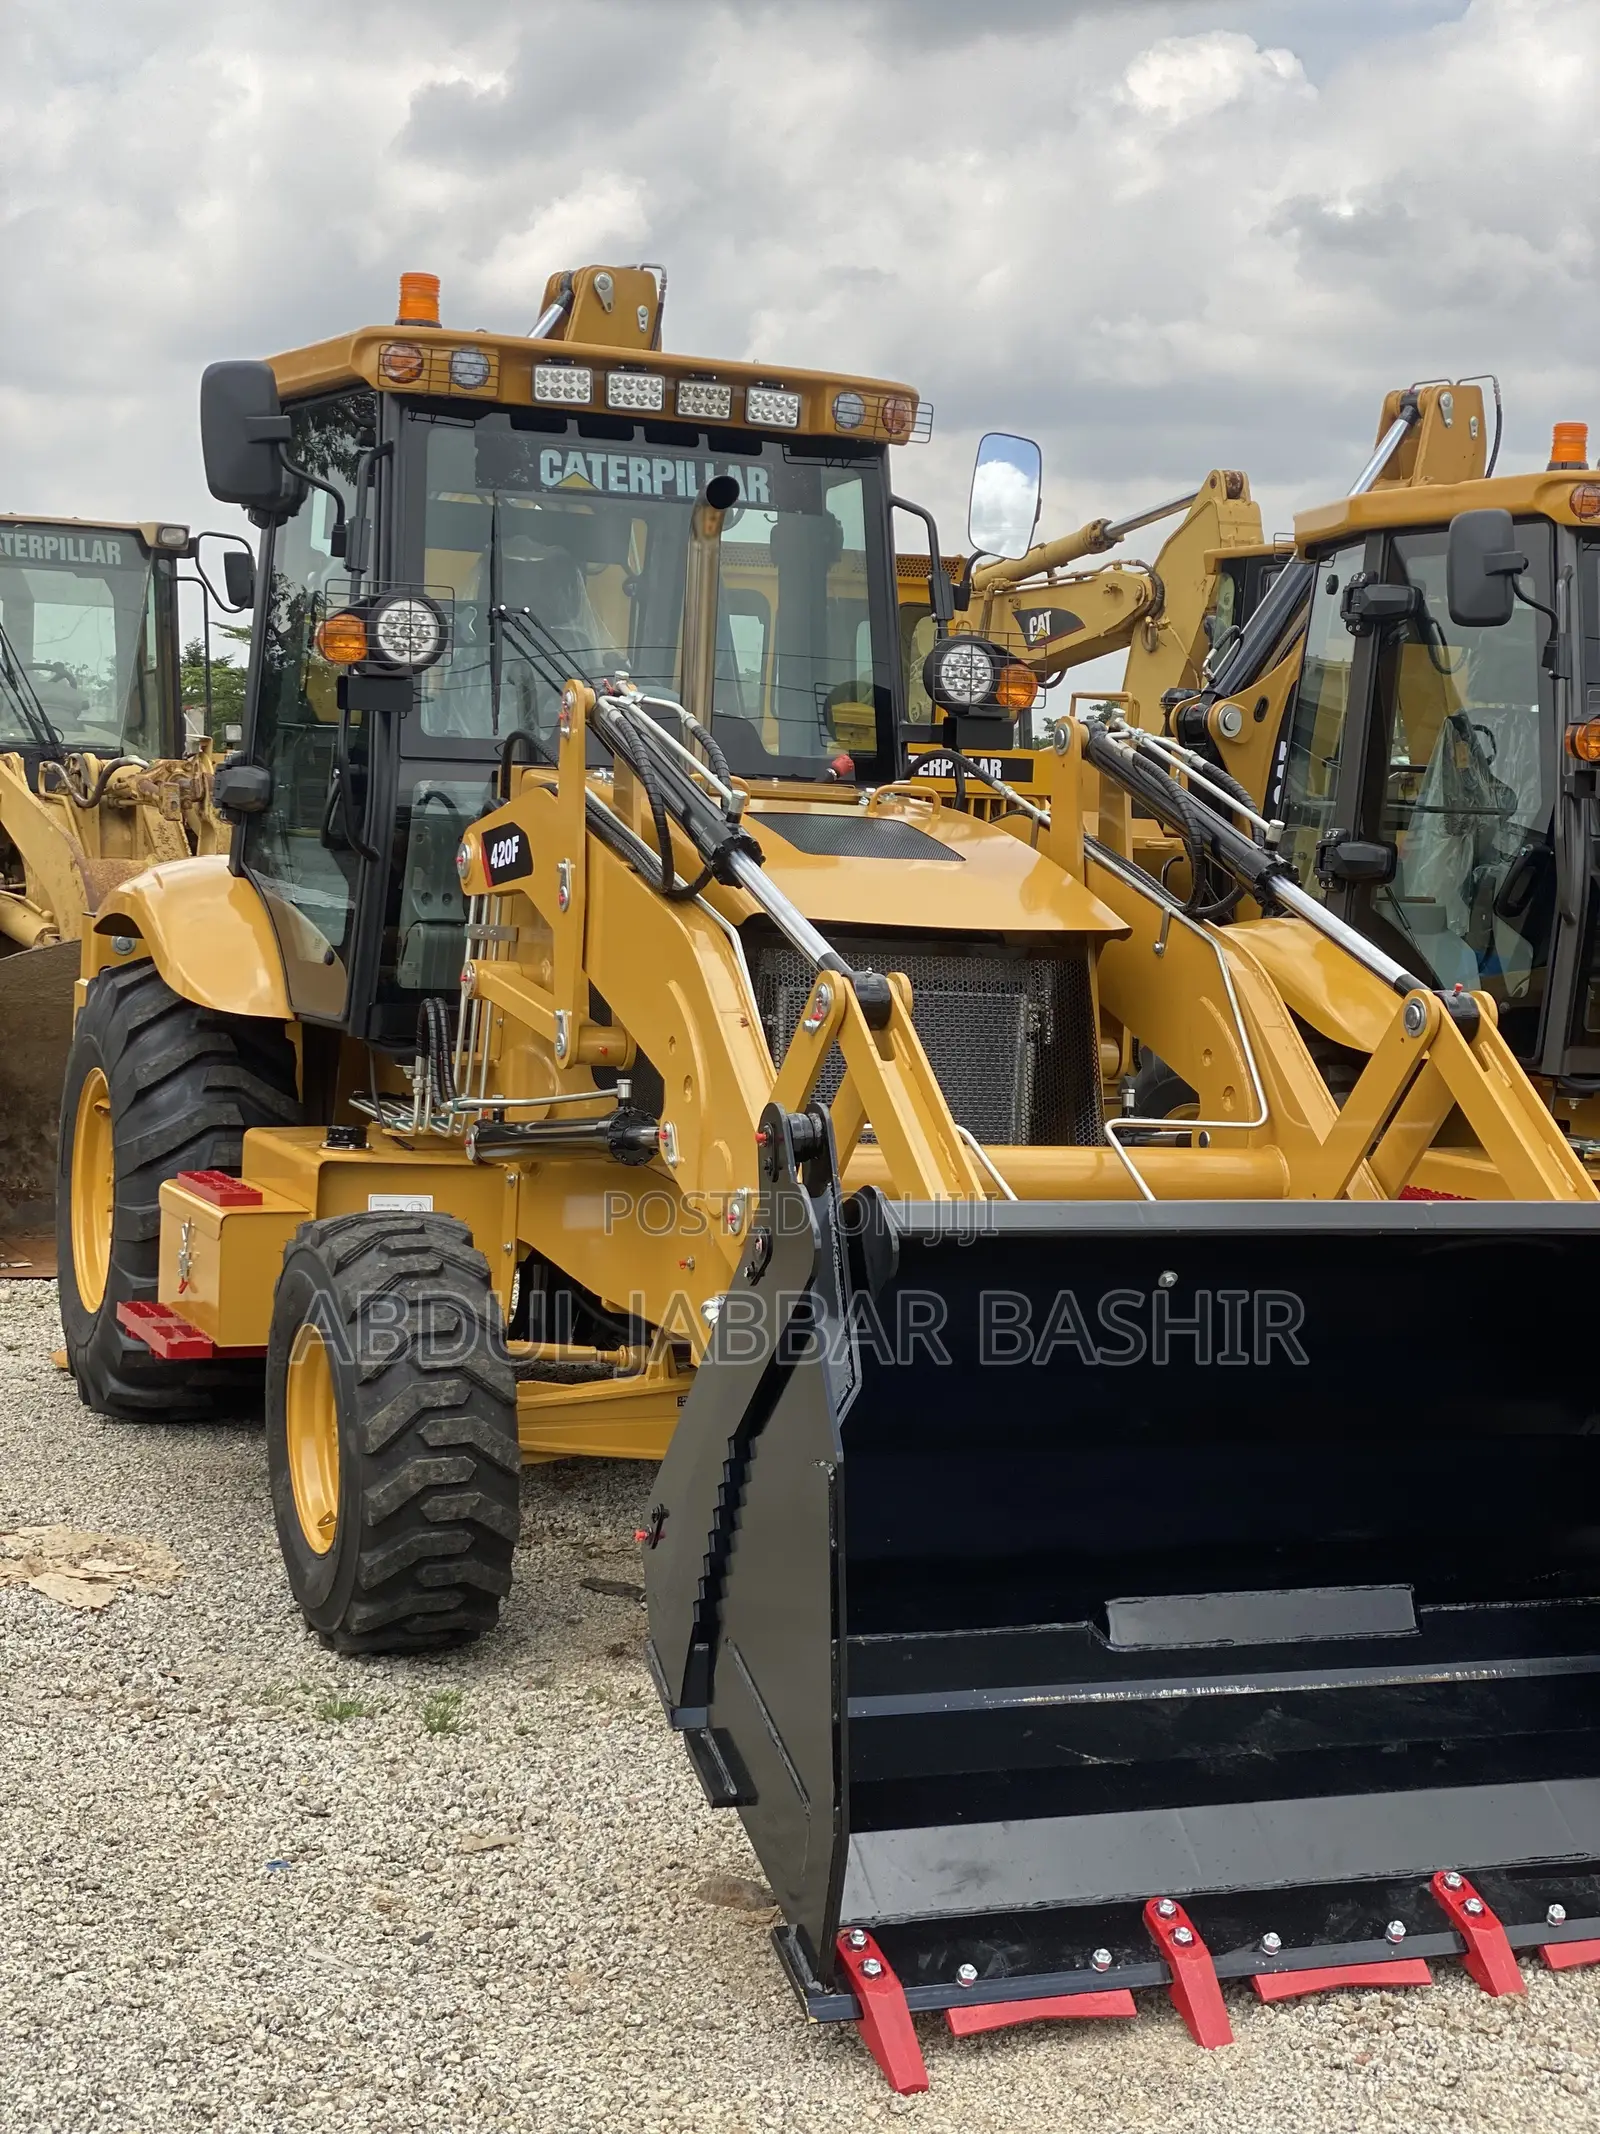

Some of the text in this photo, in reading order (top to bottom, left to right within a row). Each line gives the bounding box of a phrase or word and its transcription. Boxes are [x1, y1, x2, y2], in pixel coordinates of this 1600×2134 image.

[0, 532, 122, 565] TERPILLAR
[1029, 610, 1051, 642] CAT
[490, 835, 520, 869] 420F
